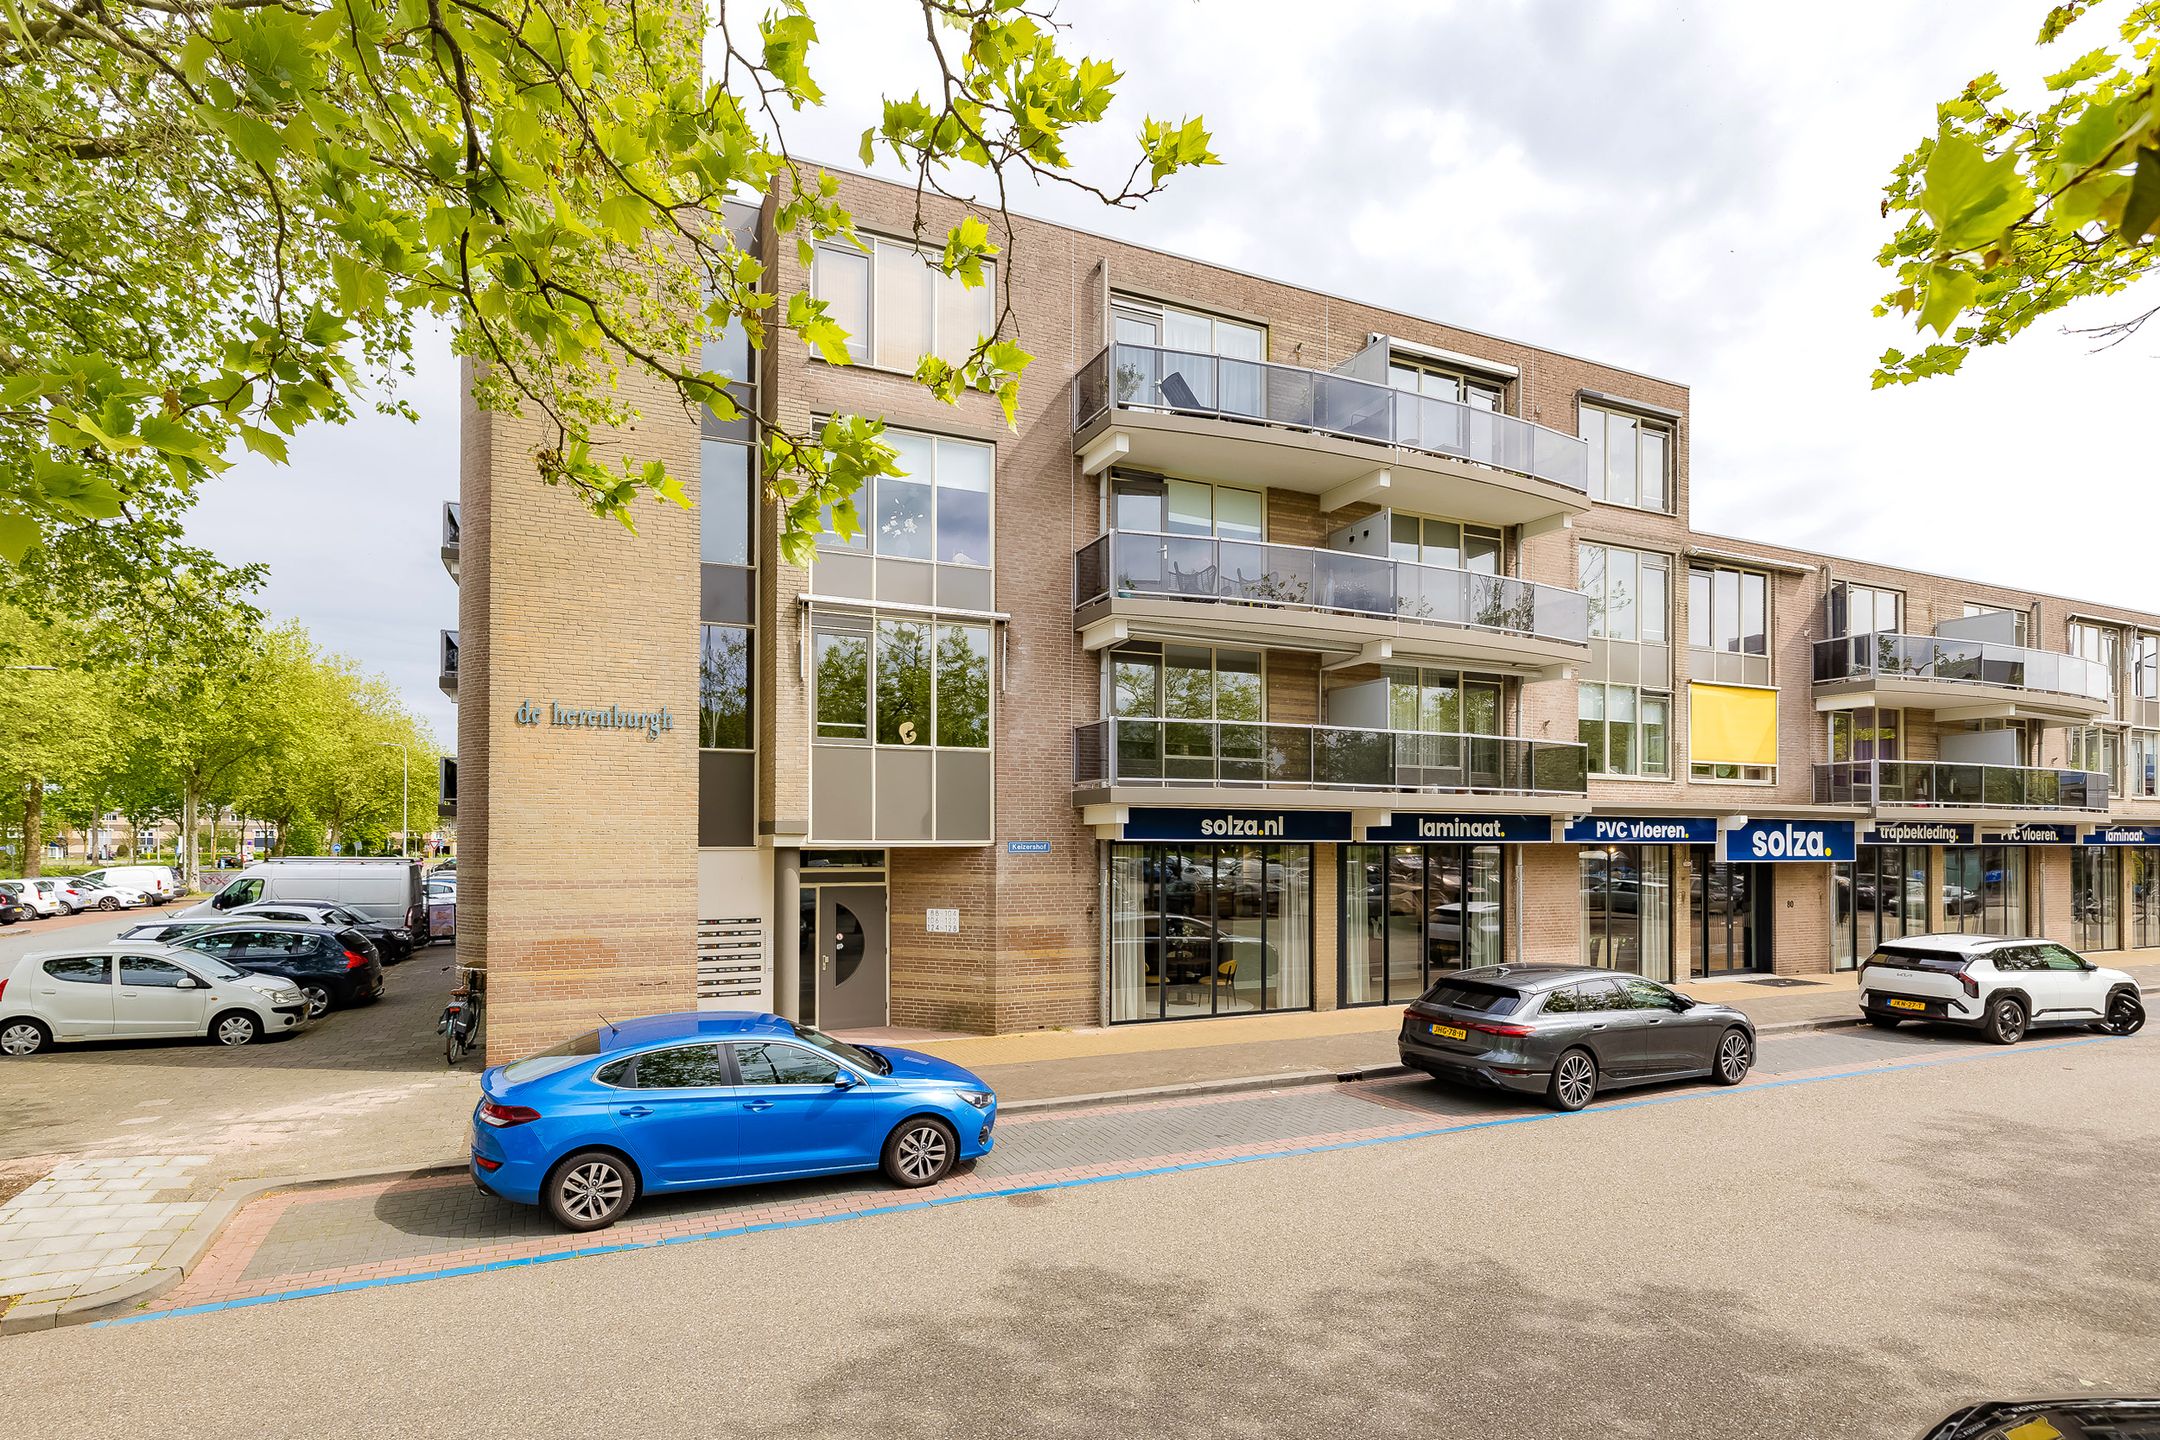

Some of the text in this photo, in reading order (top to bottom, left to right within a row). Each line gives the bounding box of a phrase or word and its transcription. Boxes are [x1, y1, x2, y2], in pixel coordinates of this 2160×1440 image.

[517, 700, 673, 738] de herenburgh
[1201, 815, 1284, 836] solza.nl
[1418, 817, 1505, 837] laminaat.
[1596, 821, 1689, 839] PVC vloeren.
[1880, 824, 1959, 843] trapbekleding.
[2022, 827, 2059, 841] vloeren.
[2105, 828, 2145, 842] laminaat.
[1752, 823, 1832, 857] solza.
[1433, 1025, 1464, 1038] JHG-78-H
